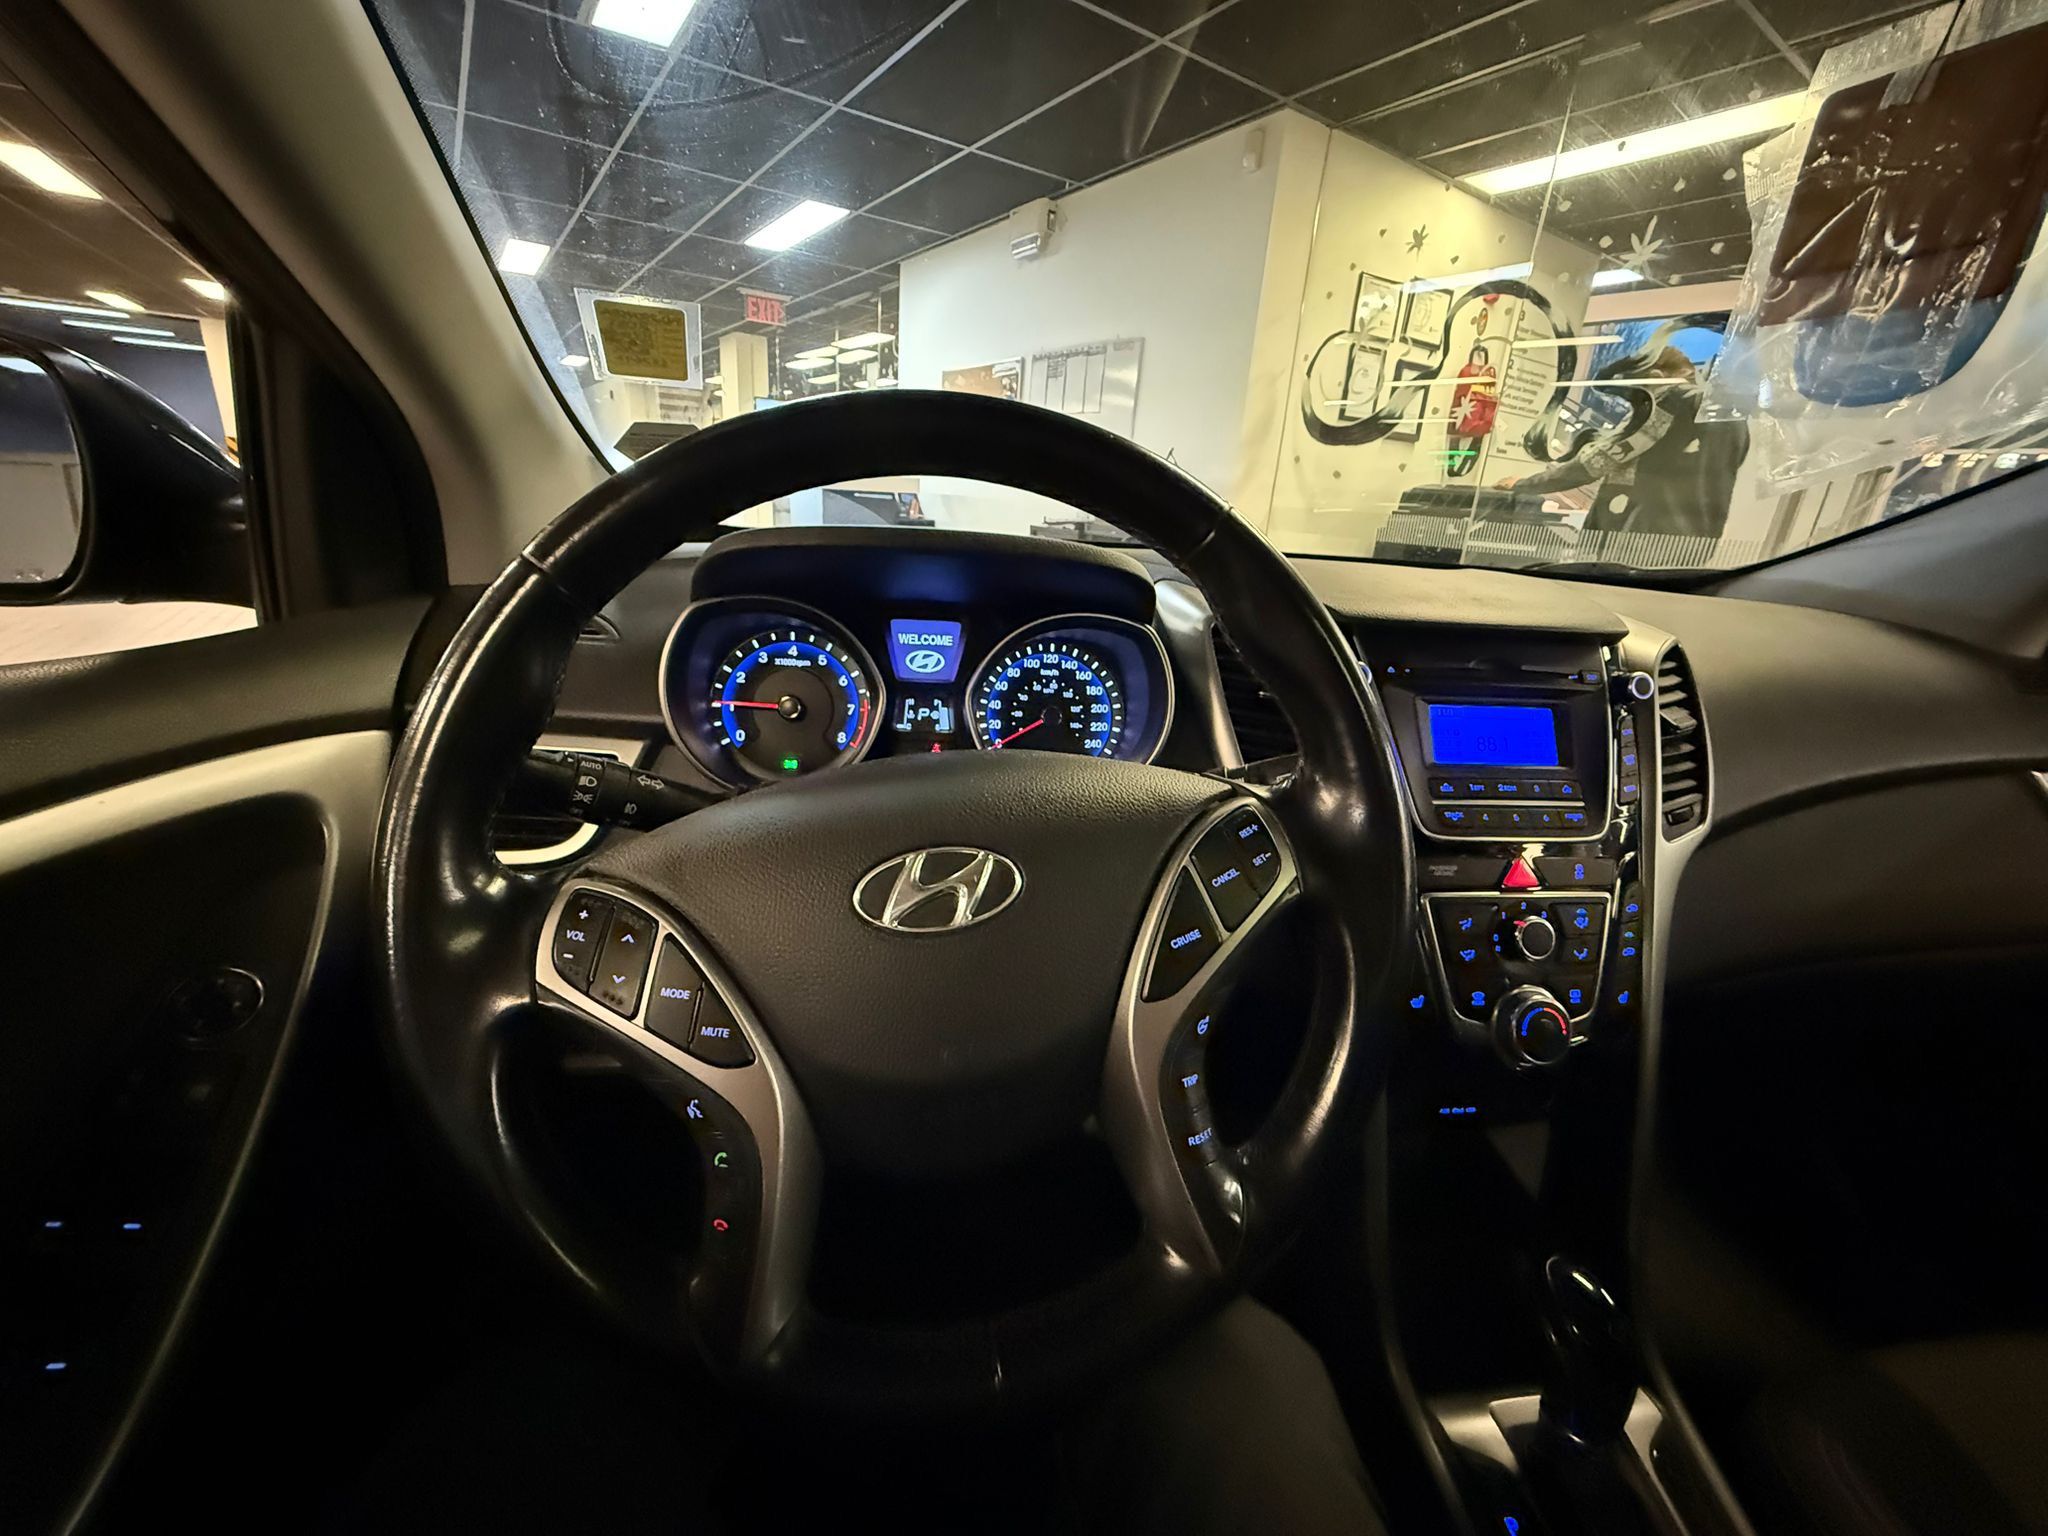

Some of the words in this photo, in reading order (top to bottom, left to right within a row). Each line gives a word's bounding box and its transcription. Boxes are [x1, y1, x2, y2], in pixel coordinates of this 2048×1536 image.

[748, 296, 781, 322] EXIT
[898, 633, 953, 646] WELCOME
[758, 651, 768, 663] 3
[787, 645, 798, 657] 4
[817, 654, 827, 666] 5
[1023, 658, 1040, 668] 100
[1043, 654, 1059, 663] 120
[1061, 660, 1078, 670] 140
[736, 671, 746, 683] 2
[1006, 667, 1020, 678] 80
[1075, 670, 1092, 680] 160
[838, 675, 848, 687] 6
[994, 681, 1008, 691] 60
[1086, 685, 1103, 696] 180
[846, 703, 856, 716] 7
[988, 700, 1001, 710] 40
[1090, 704, 1108, 714] 200
[917, 707, 930, 720] P
[988, 719, 1001, 729] 20
[1090, 722, 1108, 732] 220
[735, 729, 746, 742] 0
[836, 731, 847, 743] 8
[1084, 739, 1101, 749] 240
[581, 760, 602, 770] AUTO
[1211, 868, 1241, 888] CANCEL
[566, 930, 586, 942] VOL
[1170, 929, 1202, 950] CRUISE
[660, 987, 691, 1000] MODE
[701, 1026, 730, 1039] MUTE
[1181, 1073, 1199, 1088] TRIP
[1187, 1127, 1213, 1147] RESET
